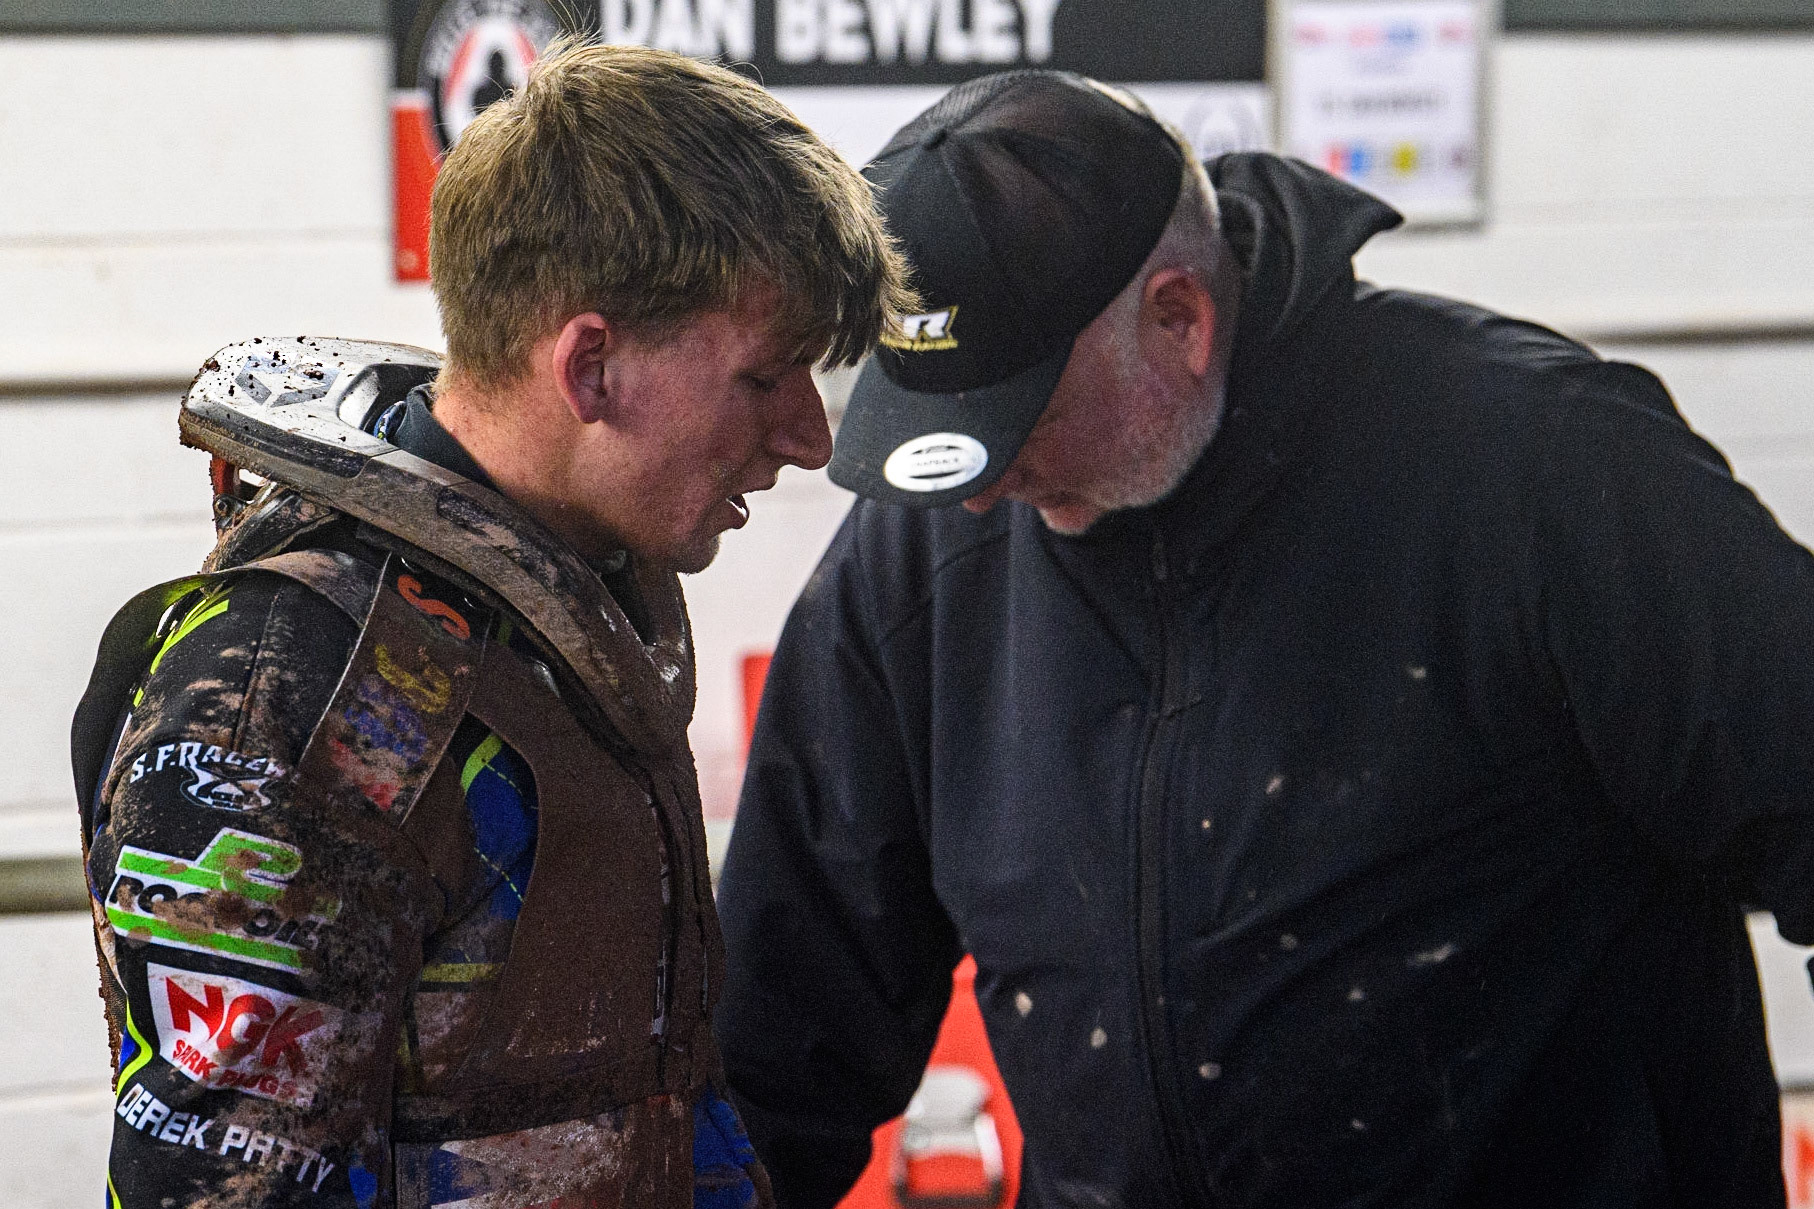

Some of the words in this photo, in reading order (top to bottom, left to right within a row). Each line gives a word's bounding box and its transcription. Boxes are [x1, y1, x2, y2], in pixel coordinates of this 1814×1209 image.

[602, 0, 756, 62] DAN
[774, 0, 1057, 64] BEWLEY
[165, 976, 326, 1078] NGK
[116, 1082, 215, 1151] DEREK
[218, 1124, 335, 1194] PATTY
